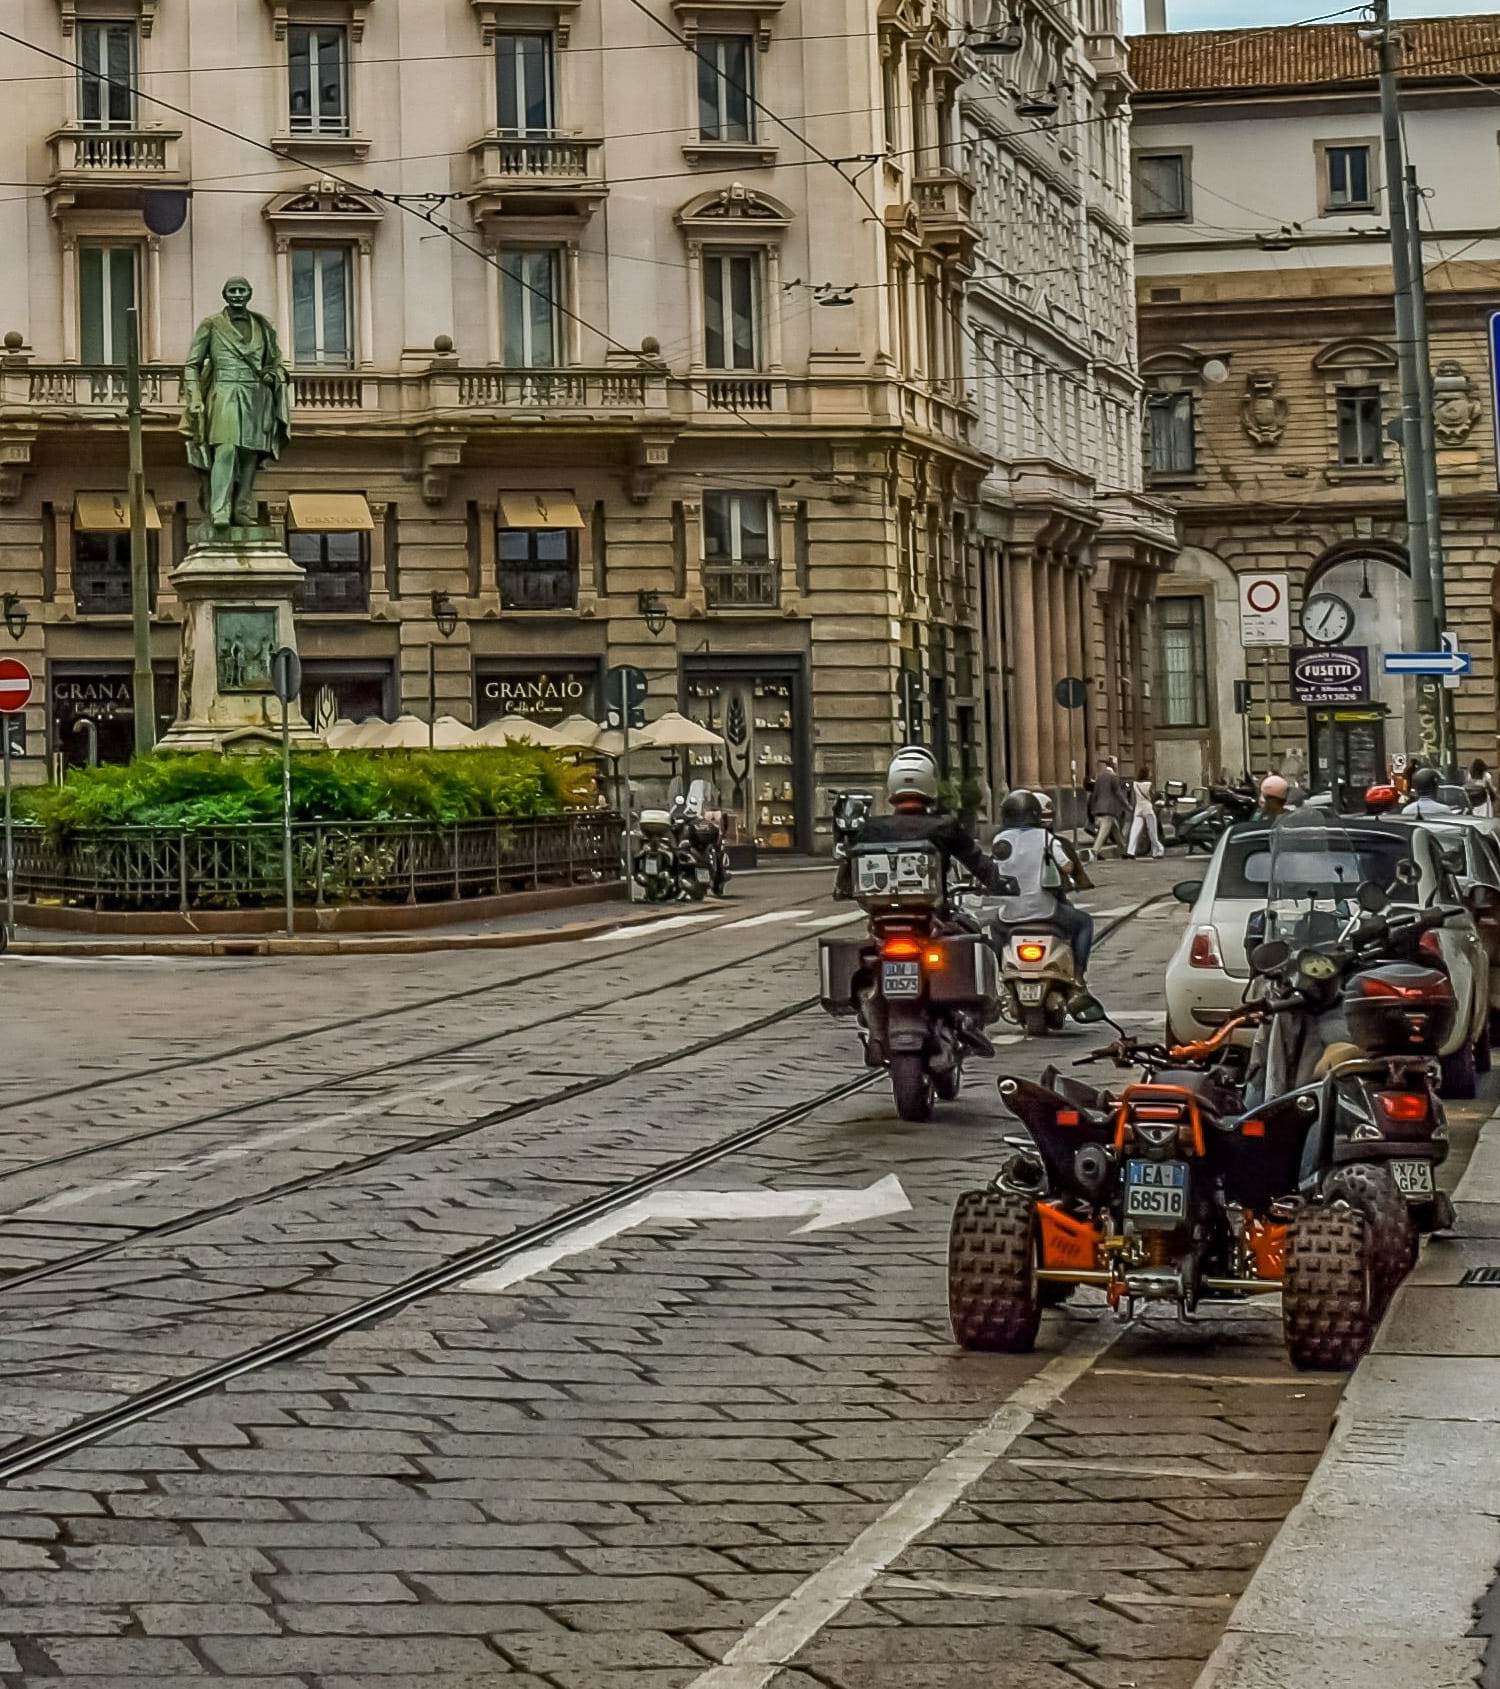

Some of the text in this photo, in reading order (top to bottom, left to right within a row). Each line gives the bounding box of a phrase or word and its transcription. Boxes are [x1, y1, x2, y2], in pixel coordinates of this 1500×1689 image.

[1304, 665, 1352, 677] FUSETTI
[54, 683, 131, 700] GRANA
[485, 681, 583, 699] GRANAIO
[1143, 1164, 1164, 1185] EA
[1130, 1191, 1182, 1213] 68518
